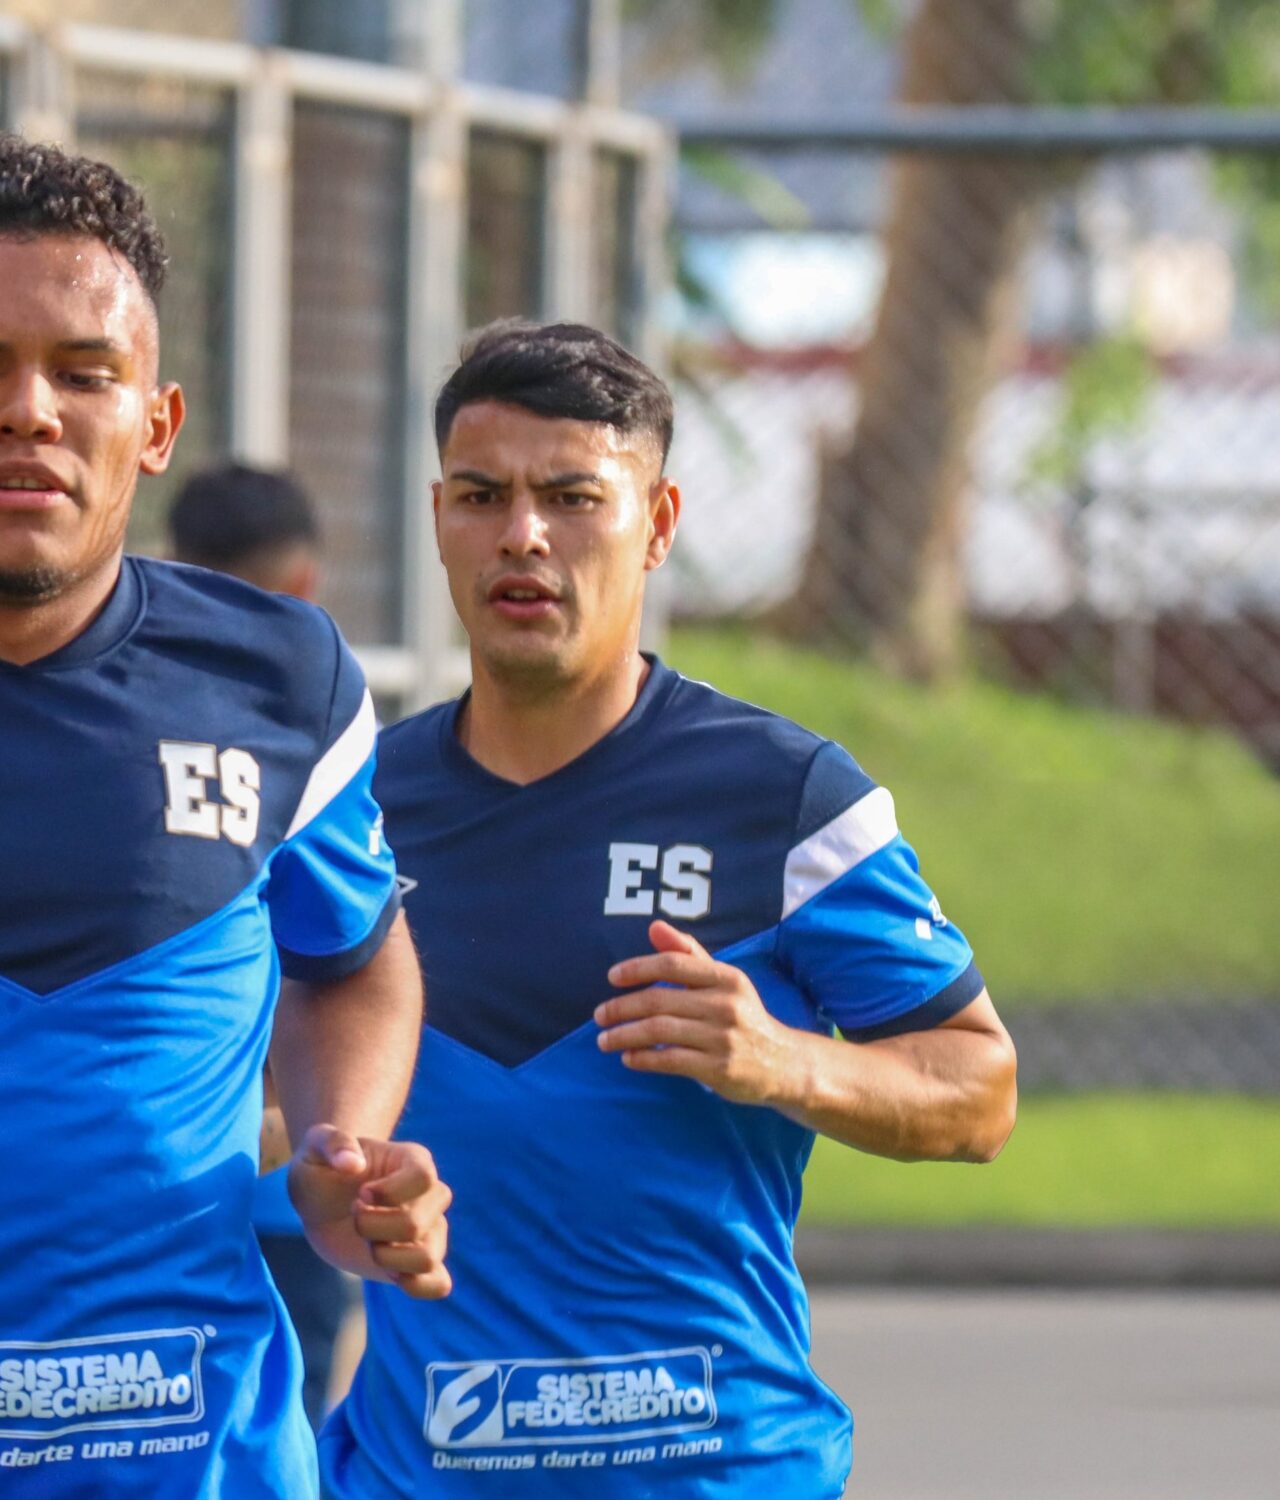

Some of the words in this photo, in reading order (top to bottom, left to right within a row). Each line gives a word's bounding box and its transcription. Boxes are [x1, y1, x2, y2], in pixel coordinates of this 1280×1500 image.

[158, 739, 261, 848] ES
[604, 842, 713, 920] ES
[537, 1367, 676, 1404] SISTEMA
[506, 1387, 706, 1428] FEDECREDITO
[0, 1443, 73, 1467] darte
[82, 1438, 129, 1460] una
[140, 1430, 210, 1456] mano
[432, 1450, 535, 1470] Queremos
[542, 1449, 606, 1469] darte
[613, 1445, 656, 1464] una
[662, 1436, 722, 1459] mano
